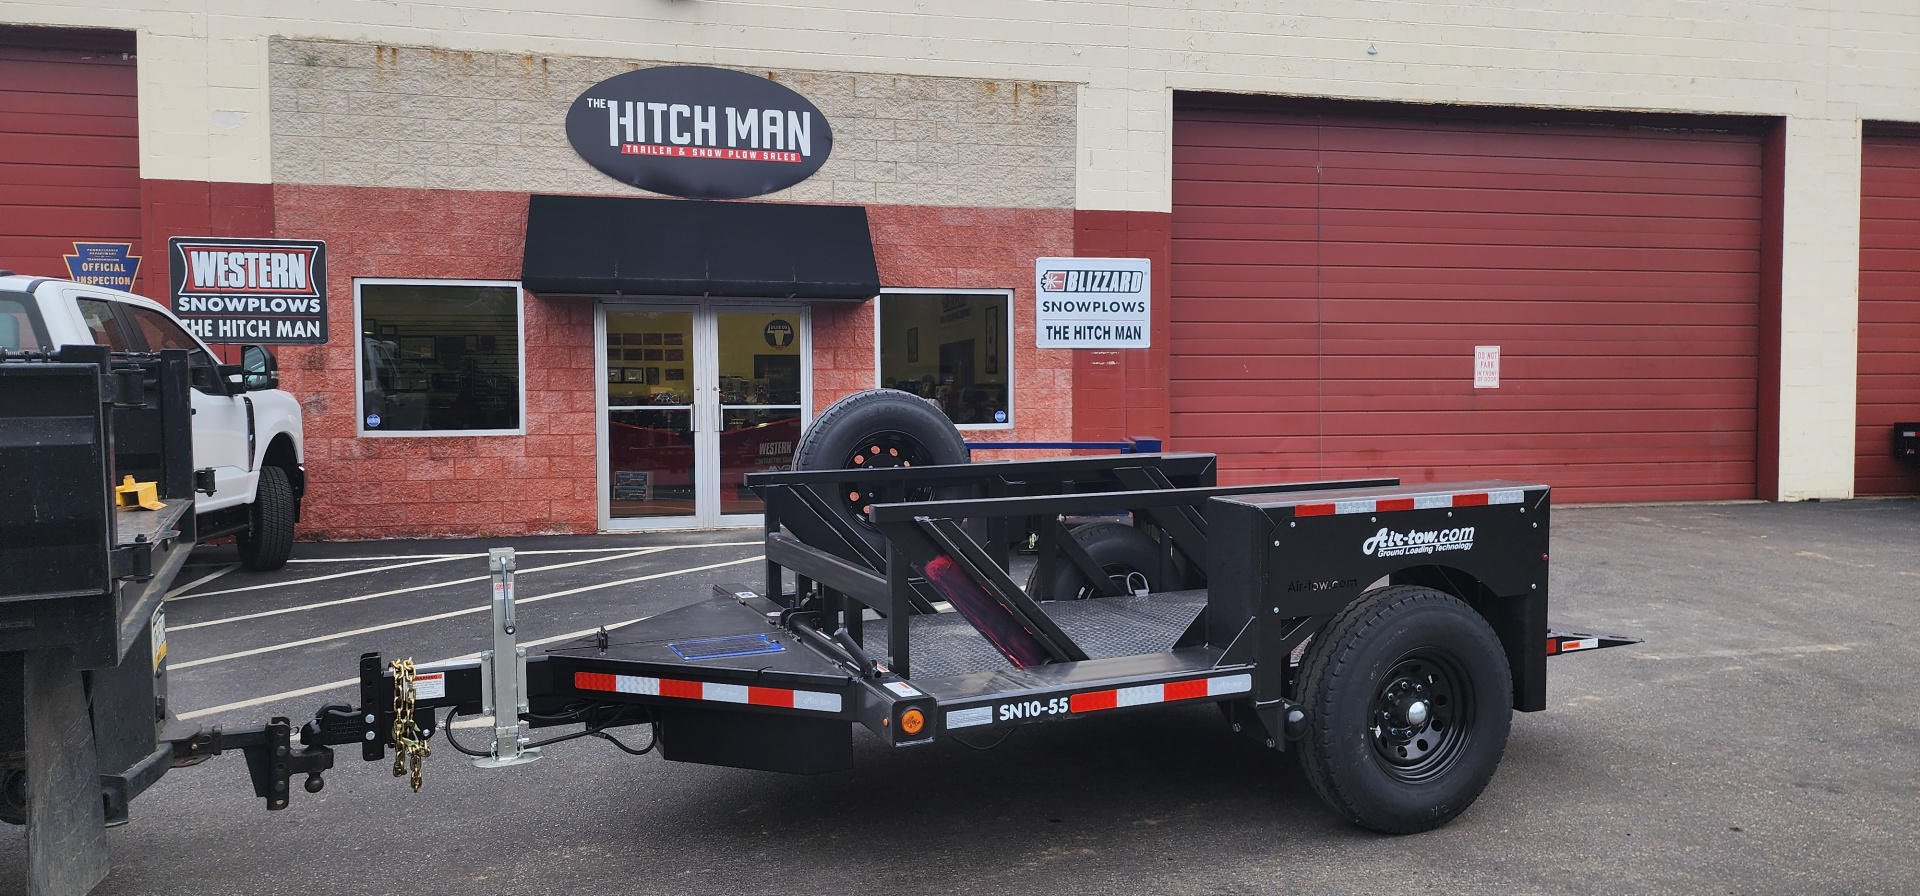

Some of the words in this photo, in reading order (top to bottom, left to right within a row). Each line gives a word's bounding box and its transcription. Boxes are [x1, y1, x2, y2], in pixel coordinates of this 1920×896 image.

[587, 97, 607, 109] THE
[607, 100, 717, 147] HITCH
[725, 107, 811, 157] MAN
[626, 144, 672, 155] TRAILER
[678, 147, 686, 156] &
[692, 148, 722, 158] SNOW
[728, 150, 757, 160] PLOW
[763, 151, 796, 161] SALES
[82, 262, 126, 272] OFFICIAL
[190, 251, 307, 289] WESTERN
[77, 276, 131, 285] INSPECTION
[1066, 271, 1142, 292] BLIZZARD
[178, 297, 321, 313] SNOWPLOWS
[1042, 301, 1145, 313] SNOWPLOWS
[218, 319, 271, 338] HITCH
[276, 320, 321, 338] MAN
[1046, 325, 1070, 340] THE
[1074, 325, 1111, 340] HITCH
[1115, 325, 1142, 340] MAN
[1478, 352, 1485, 360] DO
[1487, 352, 1497, 360] NOT
[1480, 361, 1494, 369] PARK
[759, 441, 792, 455] WESTERN
[1362, 526, 1475, 555] Air-tow.com
[1377, 547, 1404, 558] Ground
[1405, 545, 1434, 556] Loading
[1435, 541, 1474, 552] Technology
[1287, 578, 1358, 593] Air-tow.com
[999, 696, 1069, 721] SN10-55
